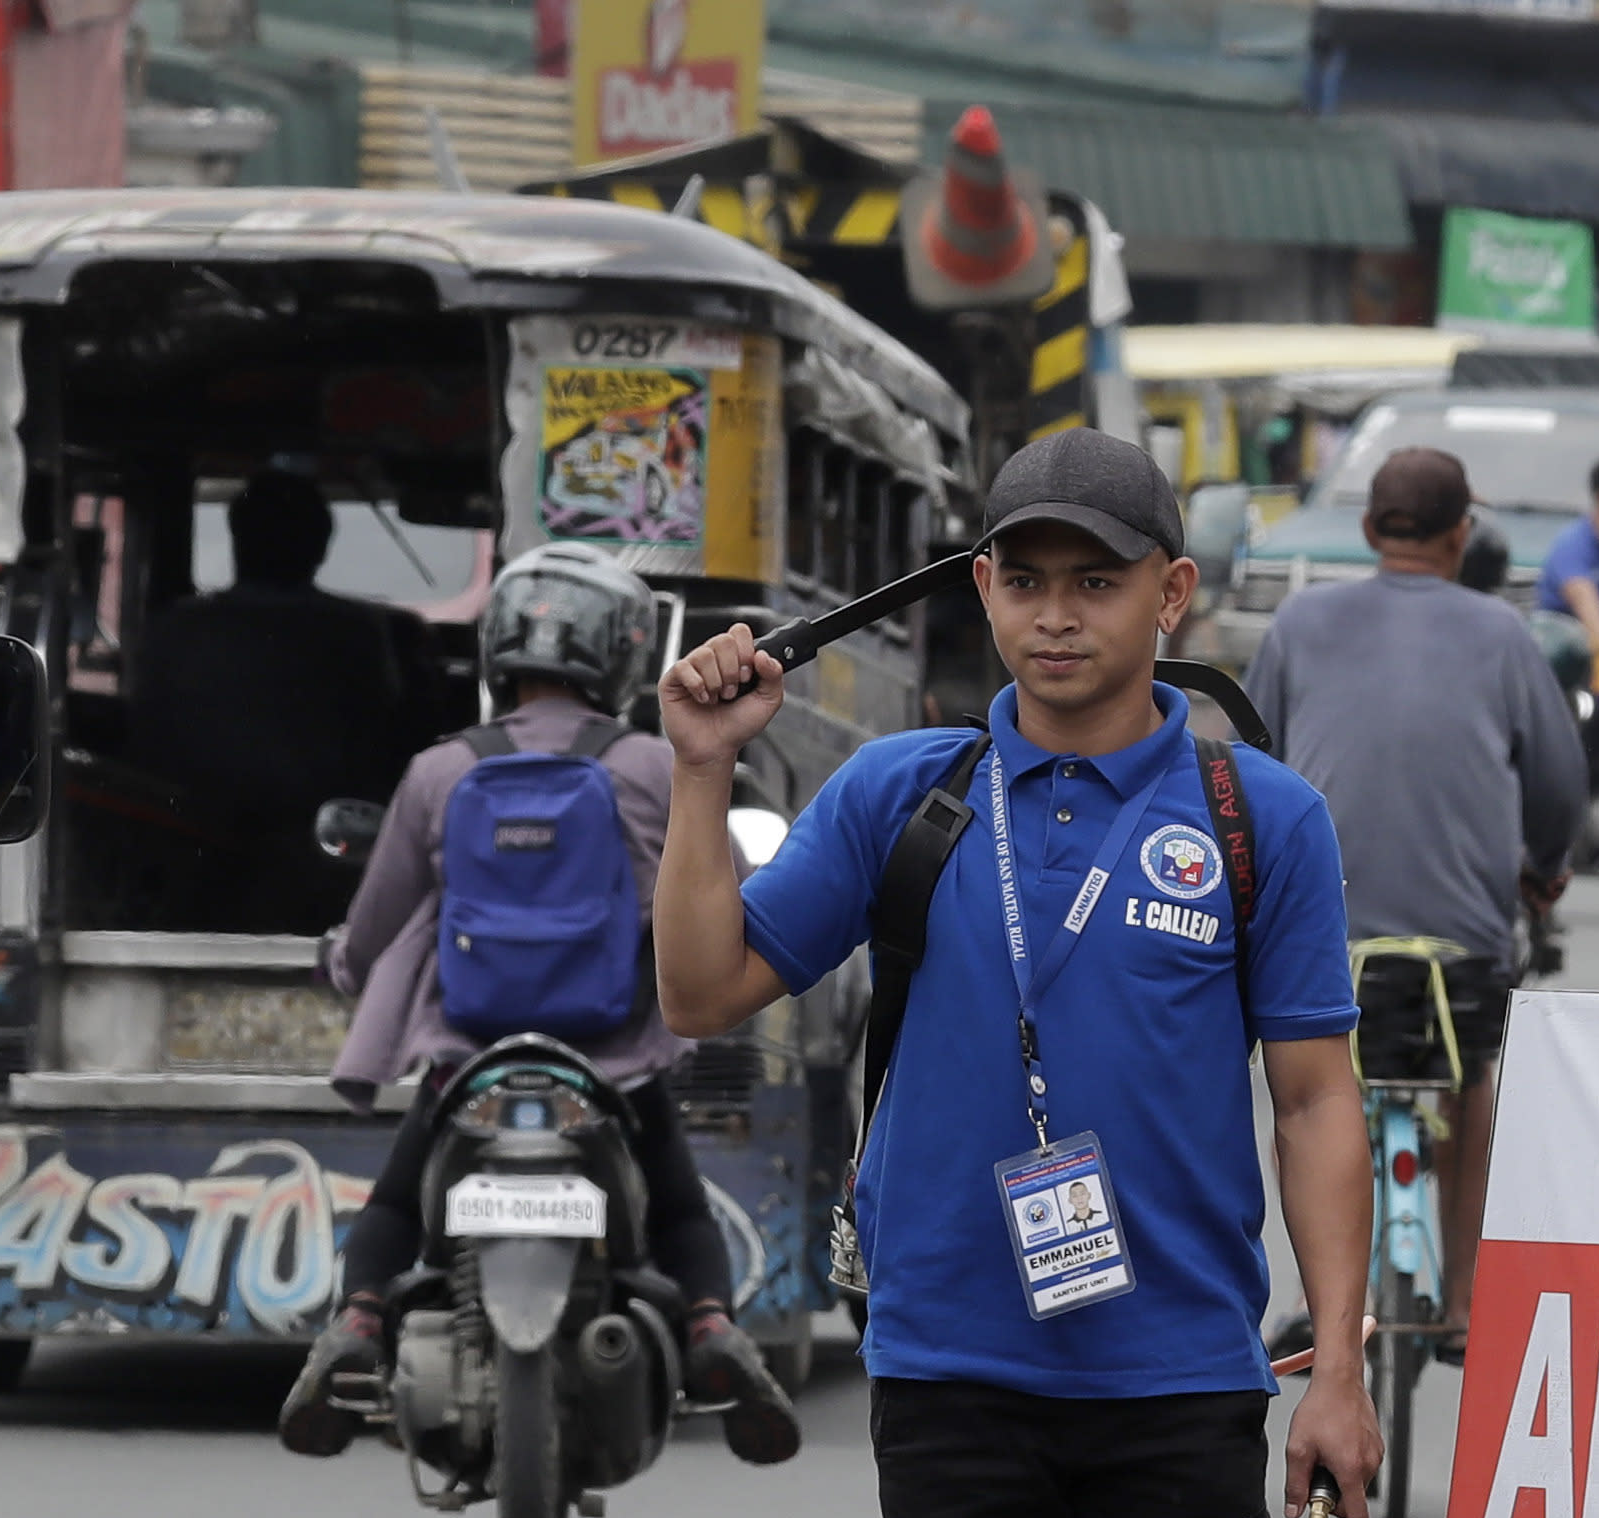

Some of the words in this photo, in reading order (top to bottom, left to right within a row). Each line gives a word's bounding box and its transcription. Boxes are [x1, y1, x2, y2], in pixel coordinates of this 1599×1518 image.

[574, 321, 677, 359] 0287
[990, 768, 1008, 840] GOVERNMENT
[996, 841, 1010, 857] OF
[998, 857, 1013, 881] SAN
[1002, 881, 1020, 926] MATEO,
[1069, 872, 1104, 929] 1SANMATEO
[1124, 897, 1142, 927] E.
[1145, 900, 1220, 946] CALLEJO
[1008, 926, 1026, 962] RIZAL
[1029, 1234, 1113, 1270] EMMANUEL
[1061, 1252, 1095, 1269] CALLEJO
